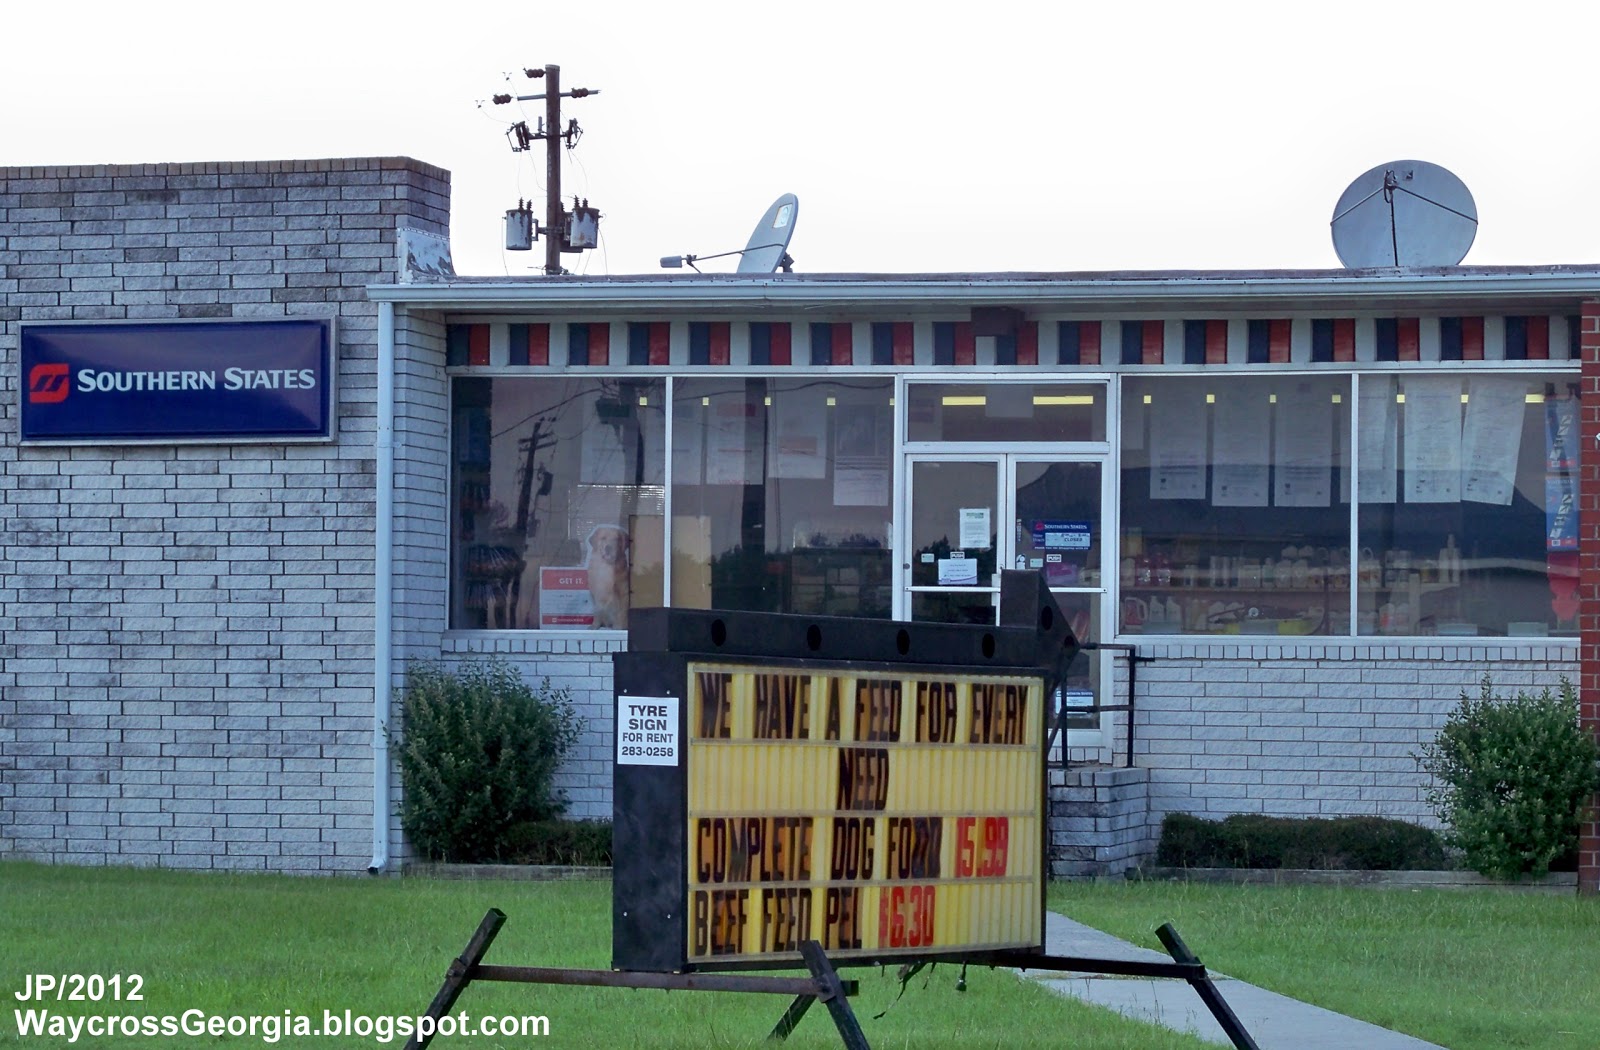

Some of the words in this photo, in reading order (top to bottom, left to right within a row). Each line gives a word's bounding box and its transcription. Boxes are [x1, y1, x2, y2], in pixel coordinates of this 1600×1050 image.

[77, 368, 216, 392] SOUTHERN
[224, 367, 316, 390] STATES
[559, 577, 573, 585] GET
[628, 705, 668, 717] TYRE
[699, 672, 732, 738] WE
[753, 674, 811, 739] HAVE
[825, 677, 842, 740] A
[853, 678, 902, 742] FEED
[915, 681, 957, 743] FOR
[969, 682, 1028, 745] EVERY
[628, 718, 667, 731] SIGN
[622, 732, 643, 743] FOR
[646, 733, 674, 744] RENT
[621, 746, 674, 757] 283-0258
[836, 747, 889, 810] NEED
[697, 817, 814, 883] COMPLETE
[831, 817, 876, 880] DOG
[695, 889, 749, 956] BEEF
[760, 888, 812, 952] FEED
